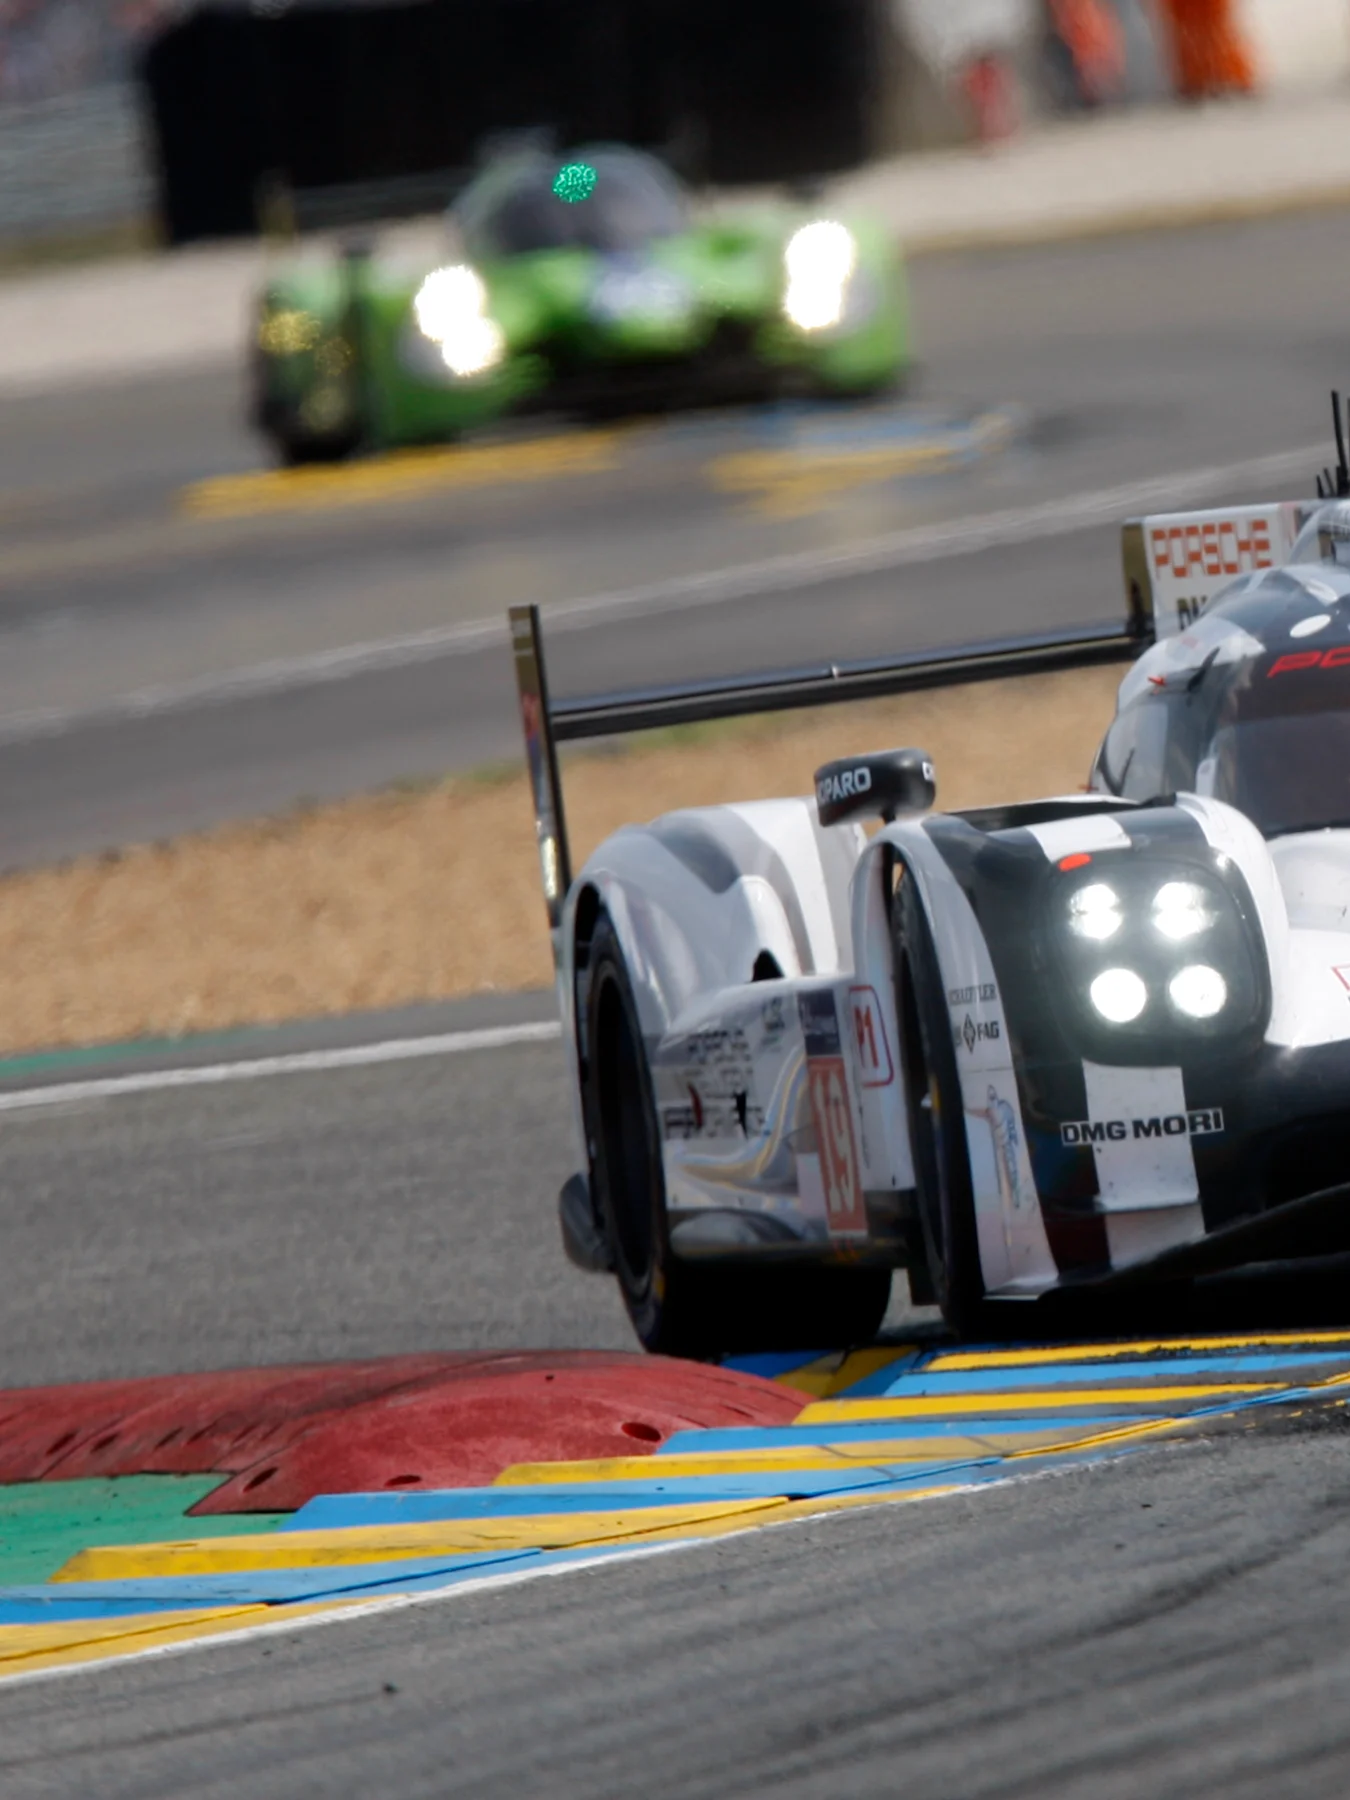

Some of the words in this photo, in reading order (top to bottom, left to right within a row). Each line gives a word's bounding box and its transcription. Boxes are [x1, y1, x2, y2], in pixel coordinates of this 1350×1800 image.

[1152, 519, 1272, 577] PORSCHE
[977, 1020, 1000, 1042] FAG
[1062, 1121, 1127, 1144] DMG
[1132, 1110, 1223, 1138] MORI
